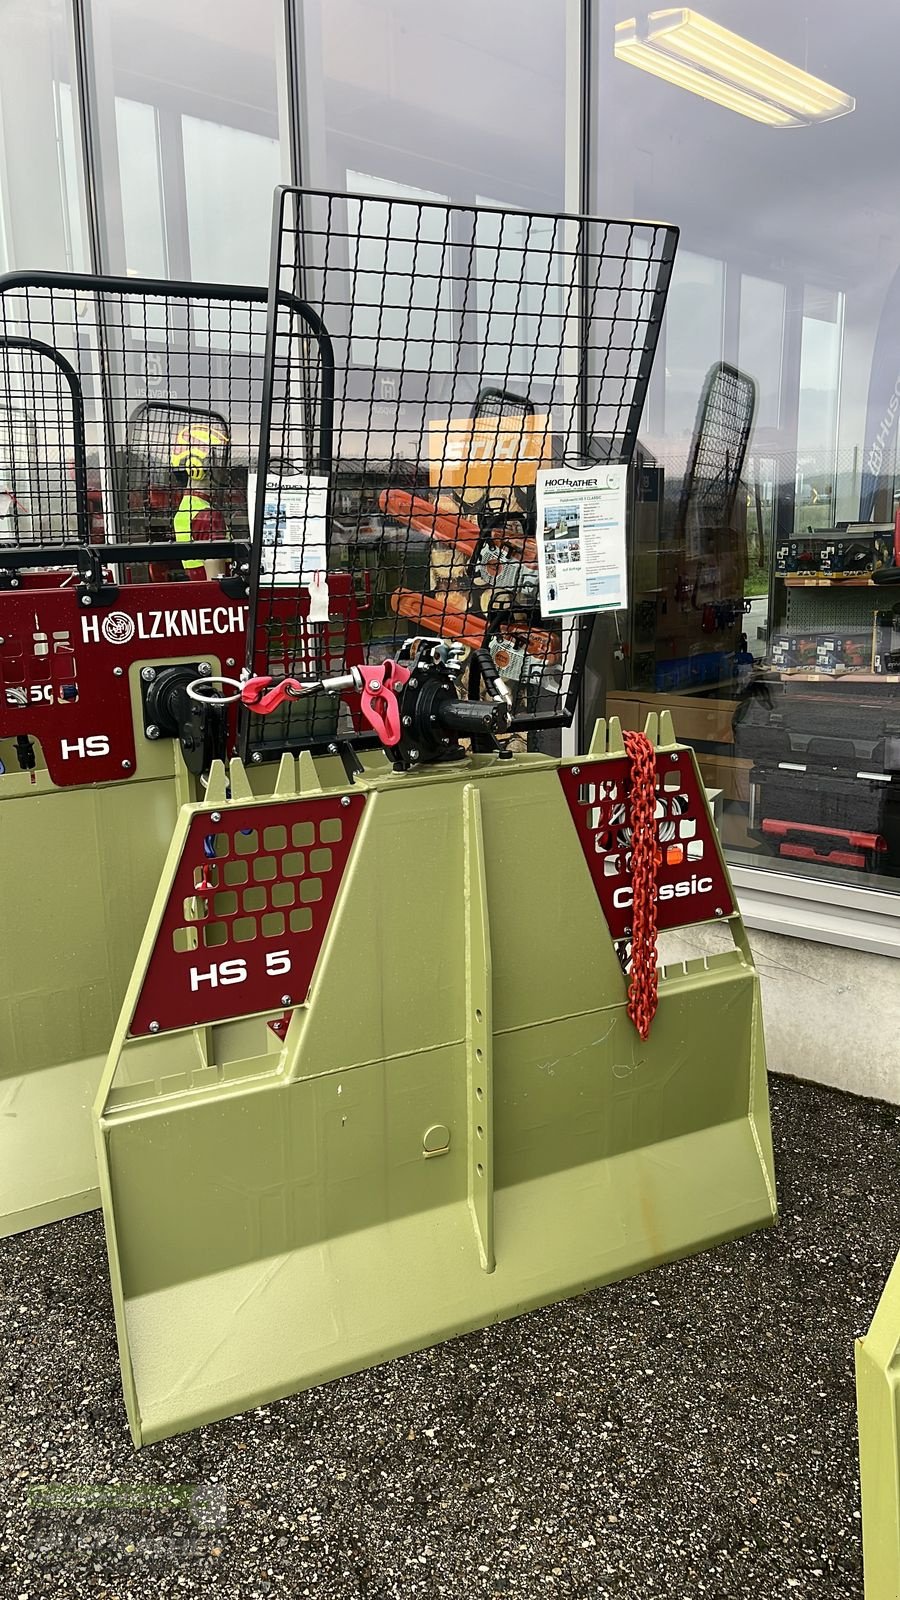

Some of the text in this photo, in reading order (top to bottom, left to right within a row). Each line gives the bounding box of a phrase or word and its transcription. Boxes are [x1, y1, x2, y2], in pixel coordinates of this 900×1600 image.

[444, 439, 538, 465] STIHL
[545, 478, 598, 488] HOCHRATHER
[61, 735, 110, 760] HS
[614, 874, 713, 908] Cssic
[190, 949, 292, 992] HS 5
